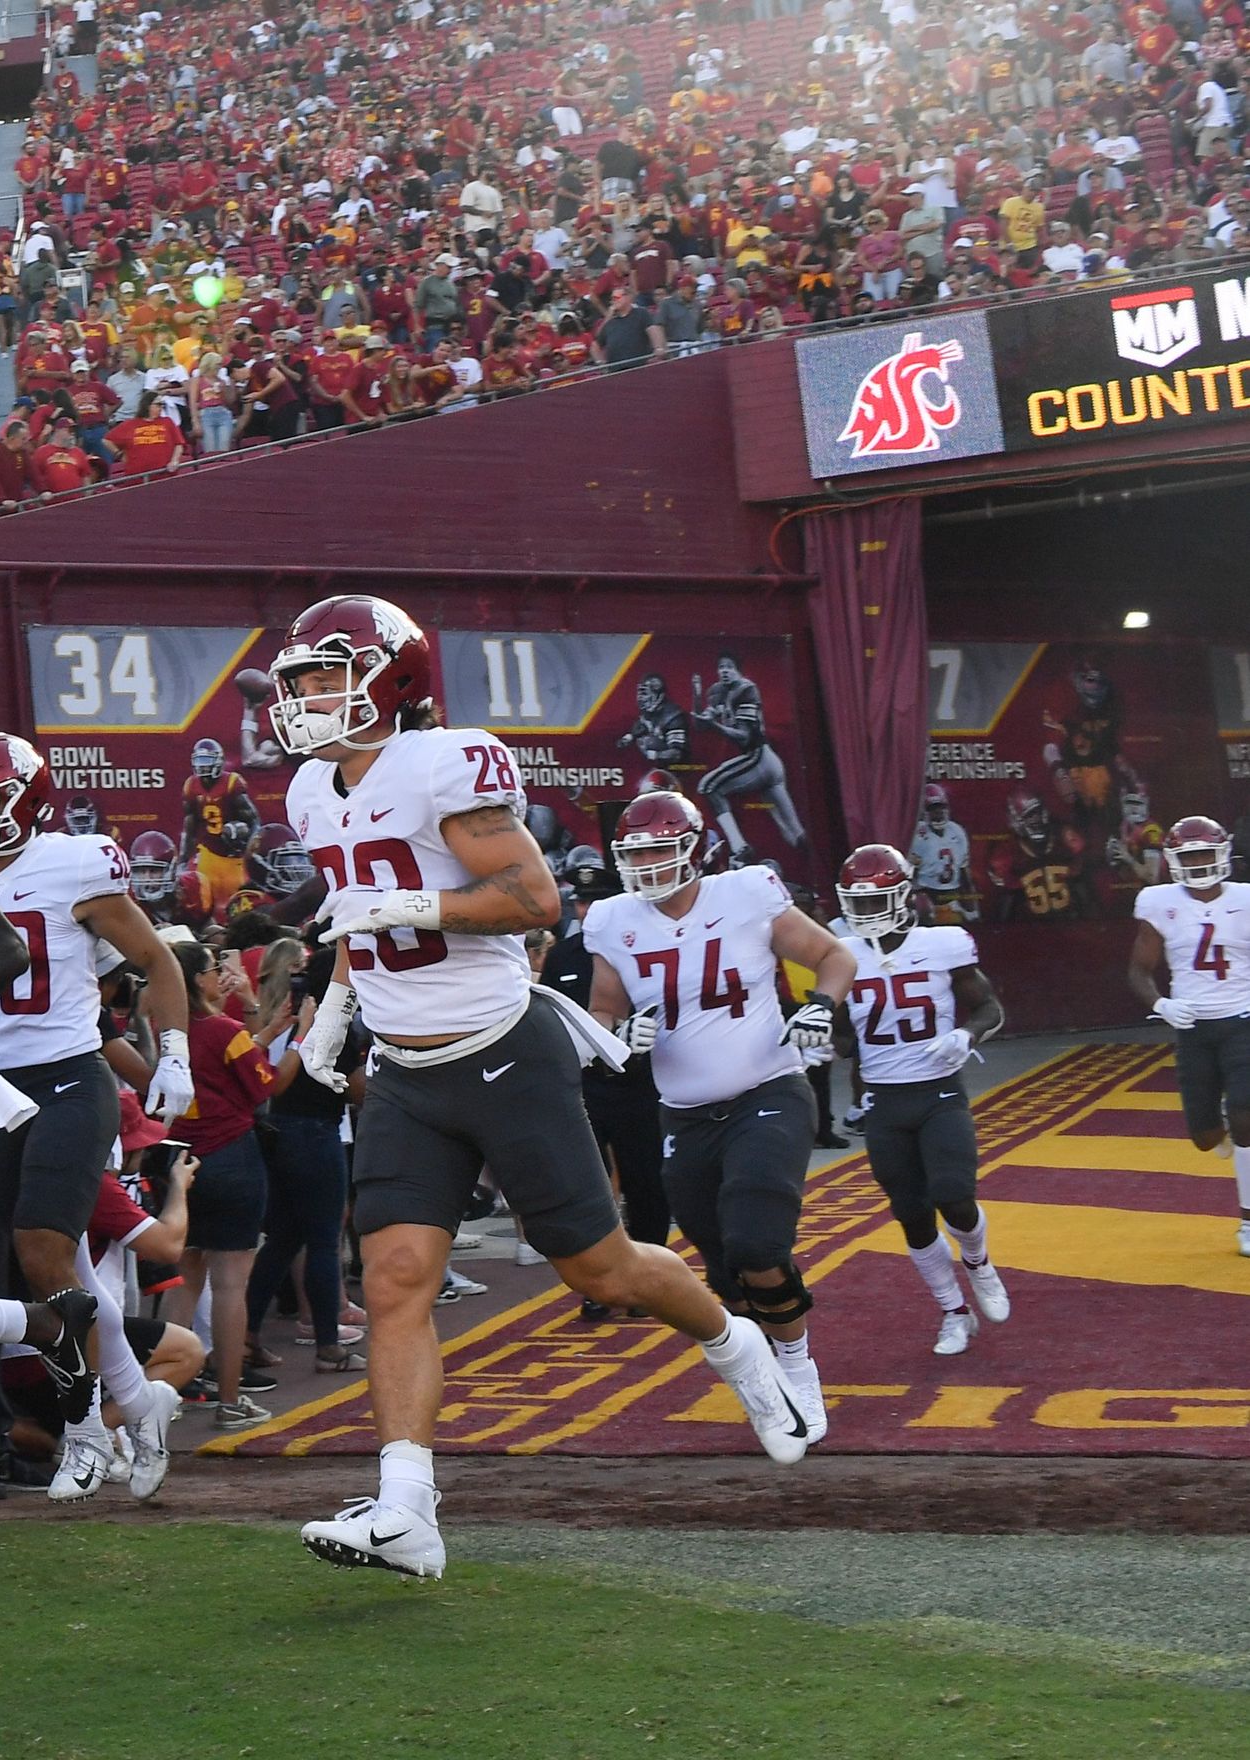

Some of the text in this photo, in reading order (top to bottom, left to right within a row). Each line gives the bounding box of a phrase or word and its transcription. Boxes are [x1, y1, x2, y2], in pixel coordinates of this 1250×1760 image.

[54, 634, 157, 715] 34
[482, 639, 543, 718] 11
[49, 747, 112, 767] BOWL
[460, 745, 517, 794] 28
[928, 743, 995, 760] ERENCE
[50, 768, 165, 790] VICTORIES
[520, 767, 624, 787] PIONSHIPS
[1020, 865, 1075, 915] 55
[1193, 922, 1231, 981] 4
[630, 936, 749, 1031] 74
[852, 970, 937, 1046] 25
